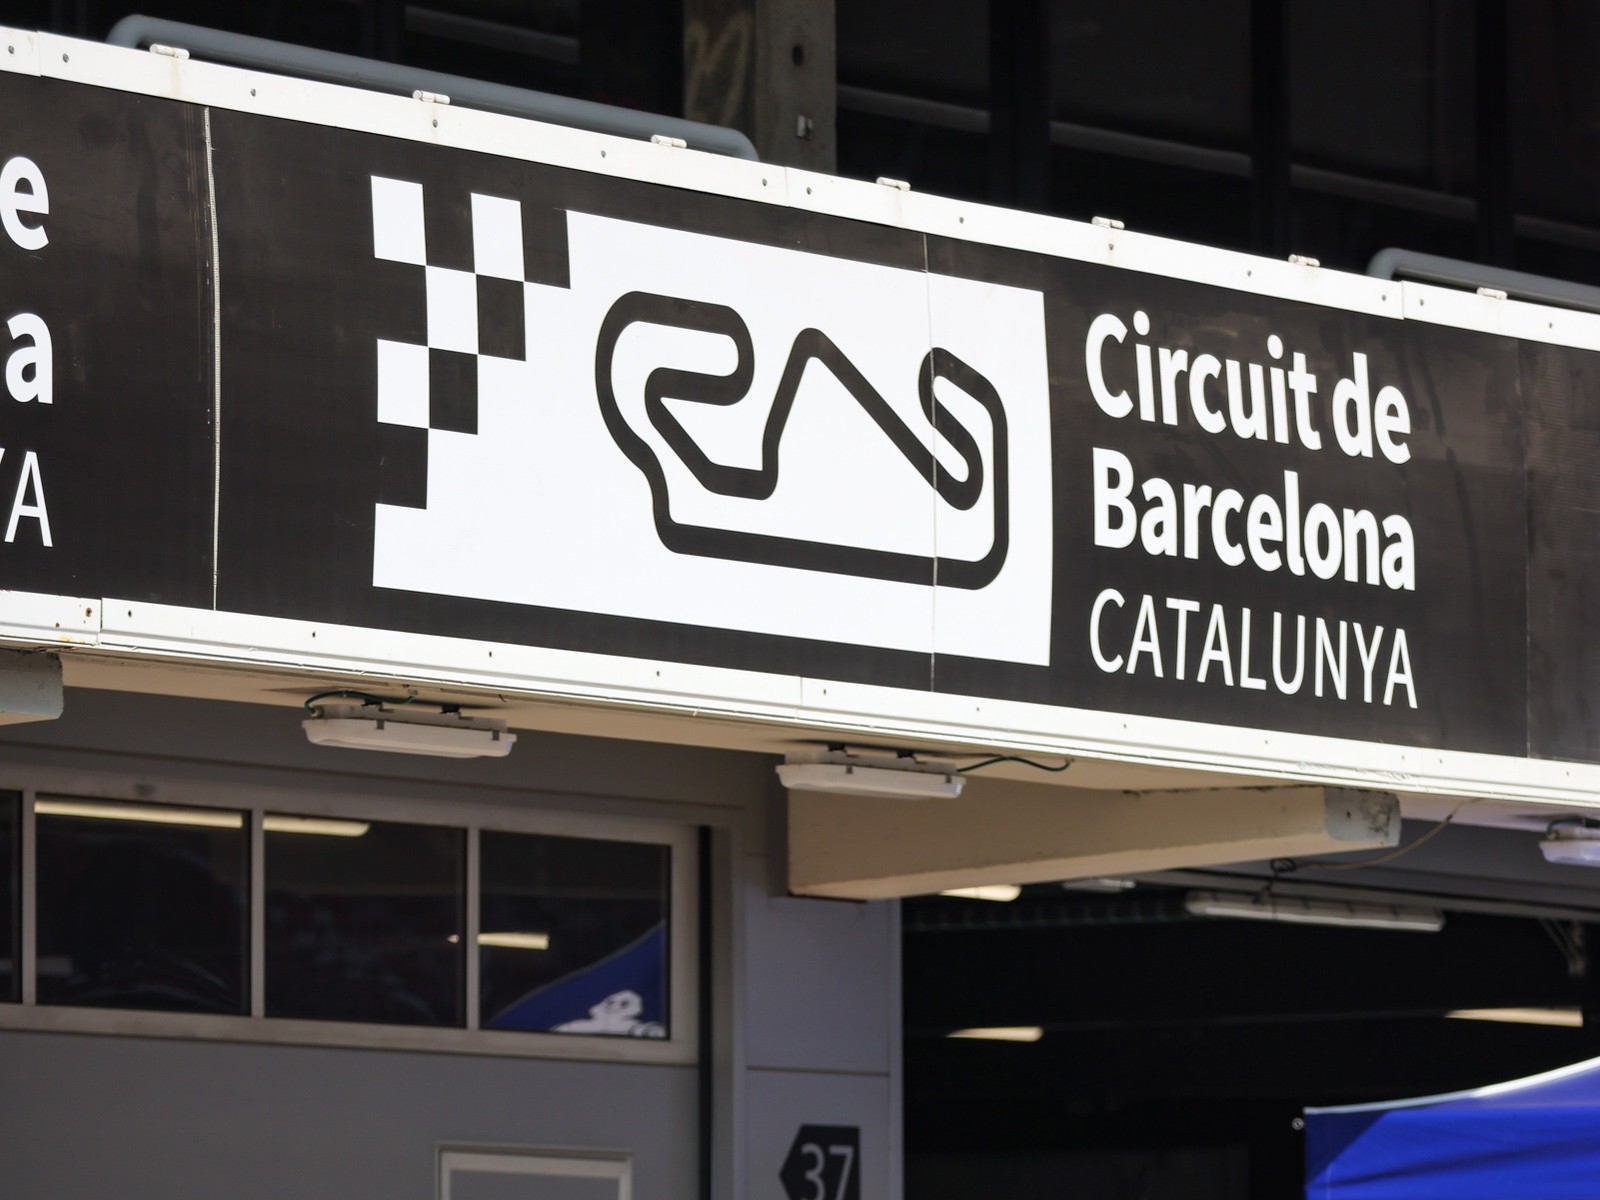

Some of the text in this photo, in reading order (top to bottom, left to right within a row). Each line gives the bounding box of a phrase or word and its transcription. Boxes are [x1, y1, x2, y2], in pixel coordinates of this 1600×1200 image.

[1086, 311, 1411, 465] Circuit de
[0, 448, 53, 547] A
[1093, 448, 1416, 591] Barcelona
[1090, 589, 1418, 709] CATALUNYA
